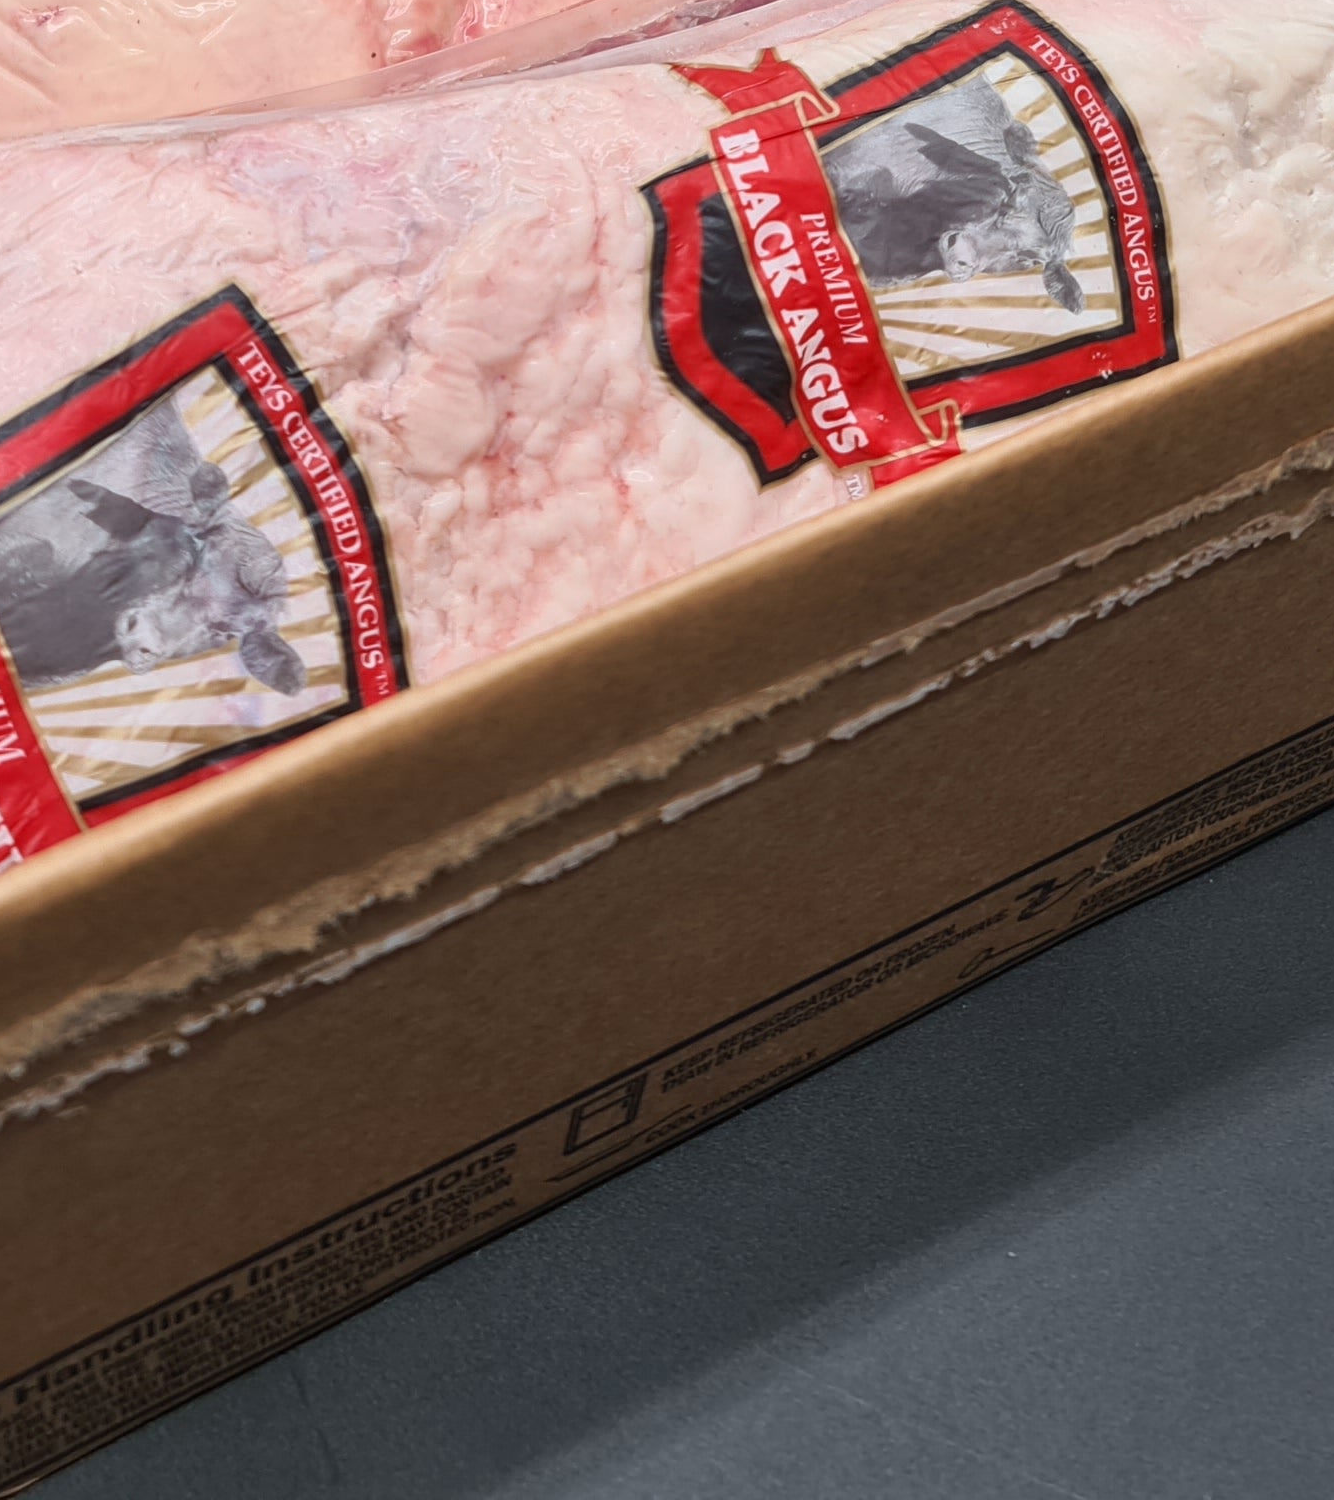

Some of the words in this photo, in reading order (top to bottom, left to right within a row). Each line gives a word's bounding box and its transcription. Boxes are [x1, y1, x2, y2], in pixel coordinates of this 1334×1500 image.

[1029, 35, 1080, 83] TEYS
[1074, 84, 1139, 206] CERTIFIED
[1122, 212, 1155, 301] ANGUS
[718, 128, 807, 298] BLACK
[782, 308, 869, 455] ANGUS
[800, 212, 869, 345] PREMIUM
[238, 341, 293, 413] TEYS
[281, 411, 362, 555] CERTIFIED
[343, 560, 384, 669] ANGUS
[1145, 819, 1201, 855] AFTER
[660, 1061, 710, 1093] THAW
[716, 1049, 734, 1065] IN
[739, 977, 873, 1053] REFRIGERATOR
[877, 963, 901, 982] OR
[663, 1048, 712, 1079] KEEP
[717, 976, 851, 1052] REFRIGERATED
[856, 961, 881, 981] OR
[16, 1281, 237, 1408] Handling
[247, 1138, 518, 1287] Instructions
